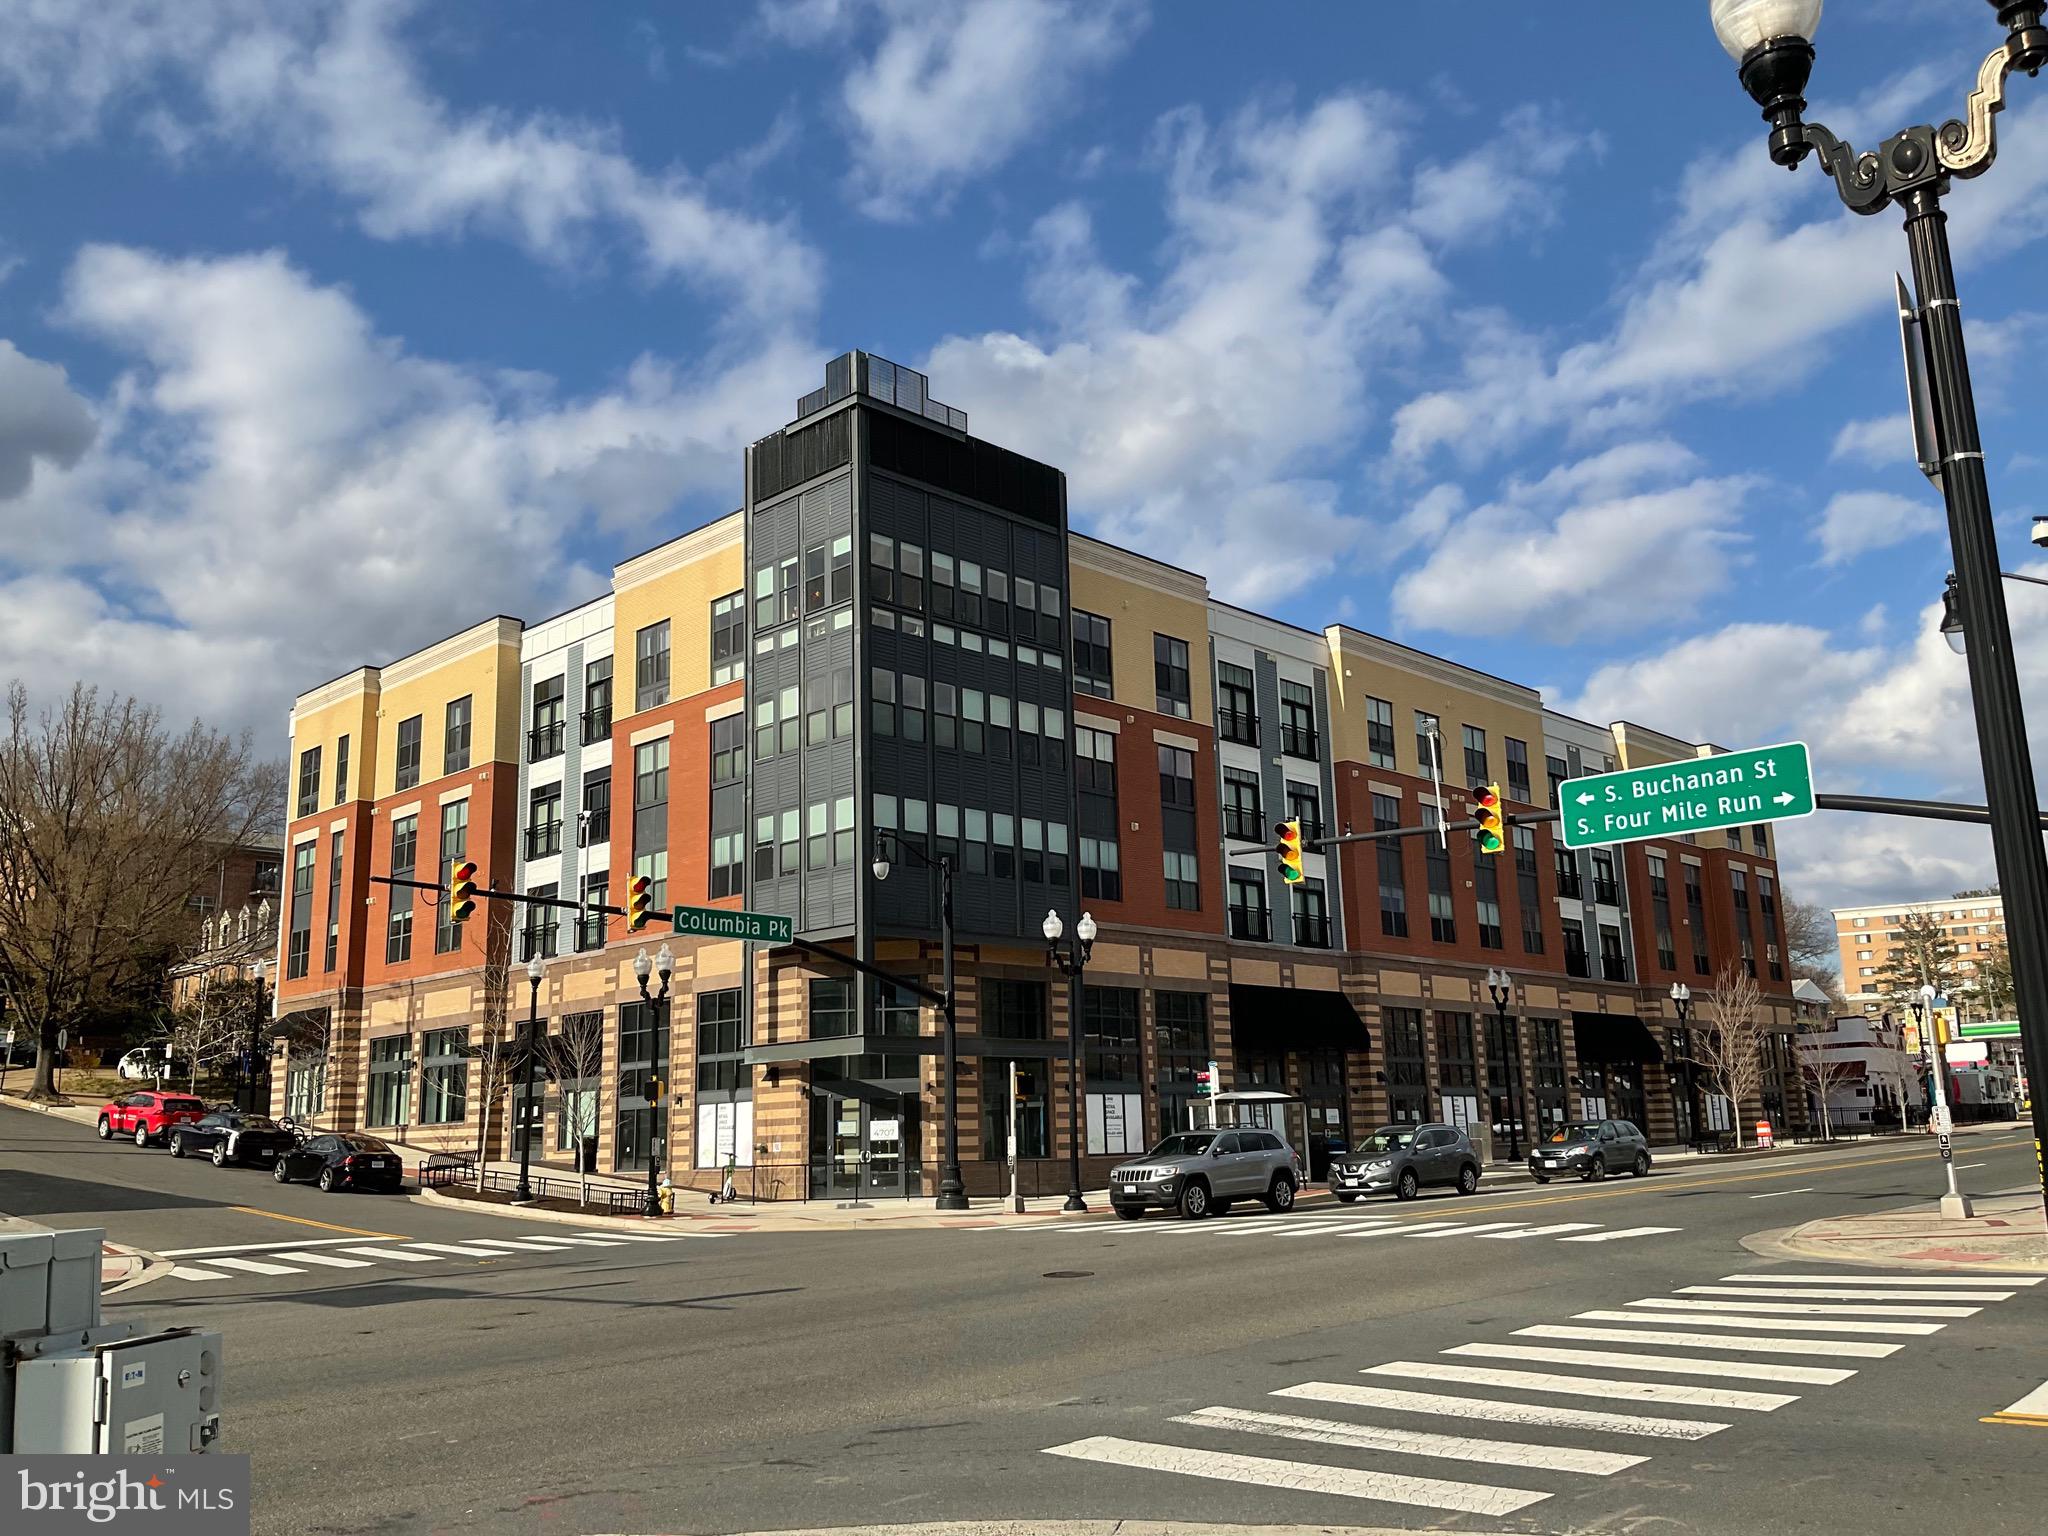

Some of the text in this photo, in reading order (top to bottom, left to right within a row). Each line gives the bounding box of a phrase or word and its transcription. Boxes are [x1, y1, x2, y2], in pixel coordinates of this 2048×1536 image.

[1604, 759, 1777, 802] S. Buchanan St
[1577, 794, 1762, 836] S. Four Mile Run
[679, 911, 788, 938] Columbia Pk
[873, 1128, 895, 1137] 4707
